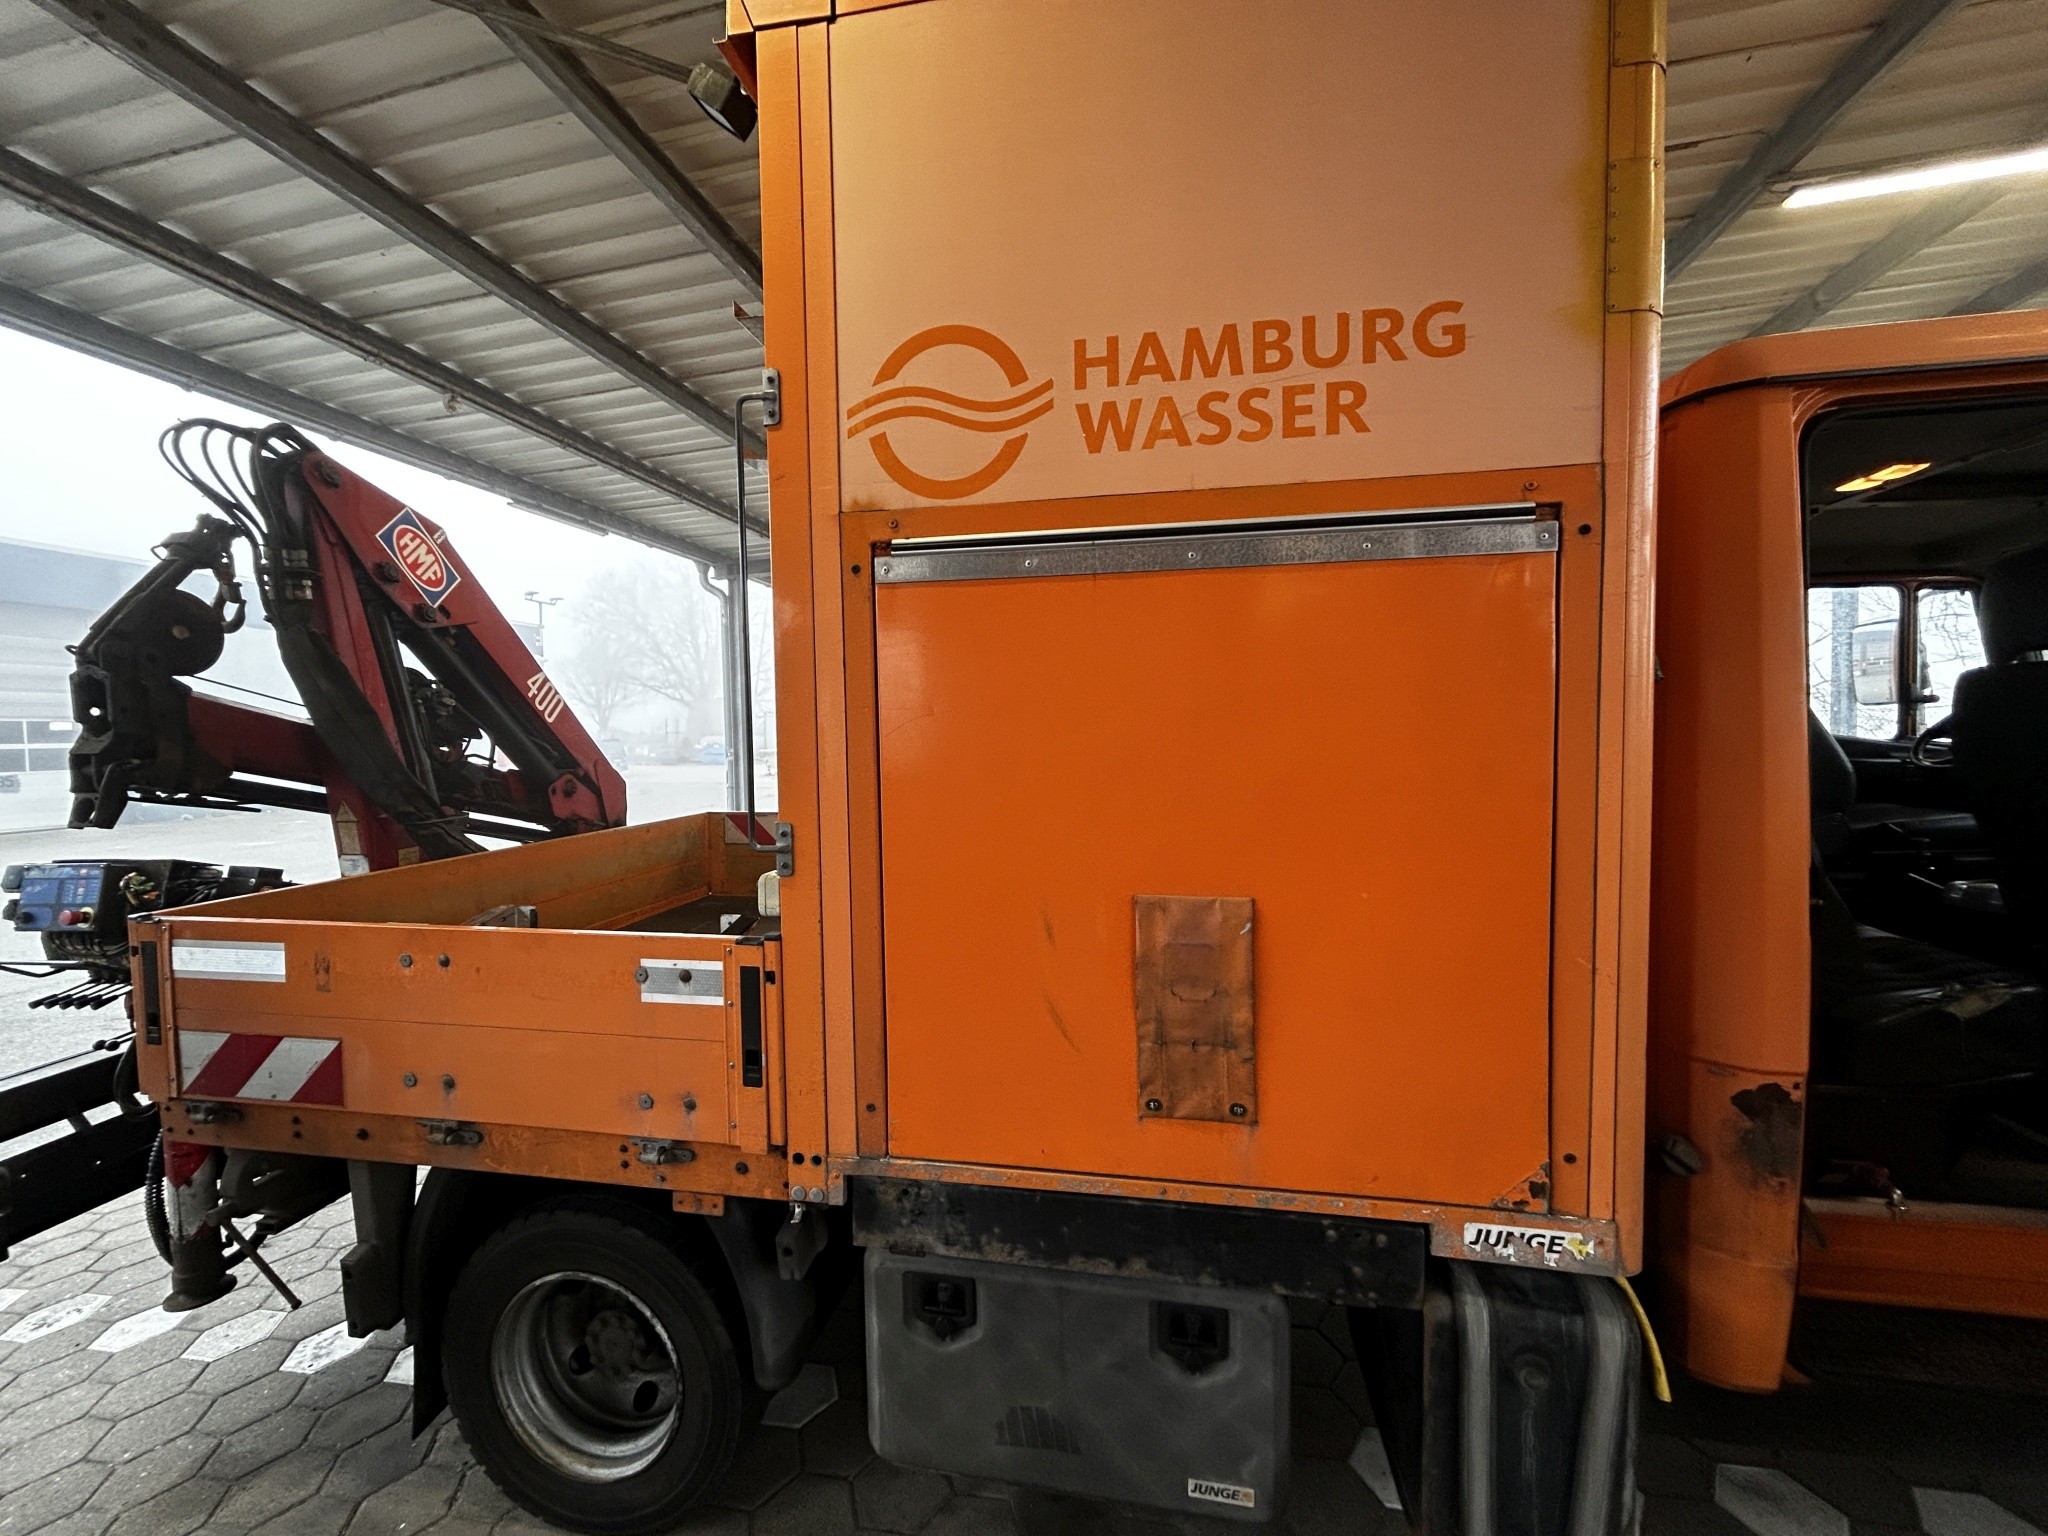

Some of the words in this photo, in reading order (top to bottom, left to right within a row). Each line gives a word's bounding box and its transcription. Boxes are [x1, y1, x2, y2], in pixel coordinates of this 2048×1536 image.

[1073, 300, 1467, 390] HAMBURG
[1075, 380, 1371, 454] WASSER
[399, 532, 442, 582] HMF
[526, 671, 564, 723] 400
[1191, 1482, 1241, 1500] JUNGE
